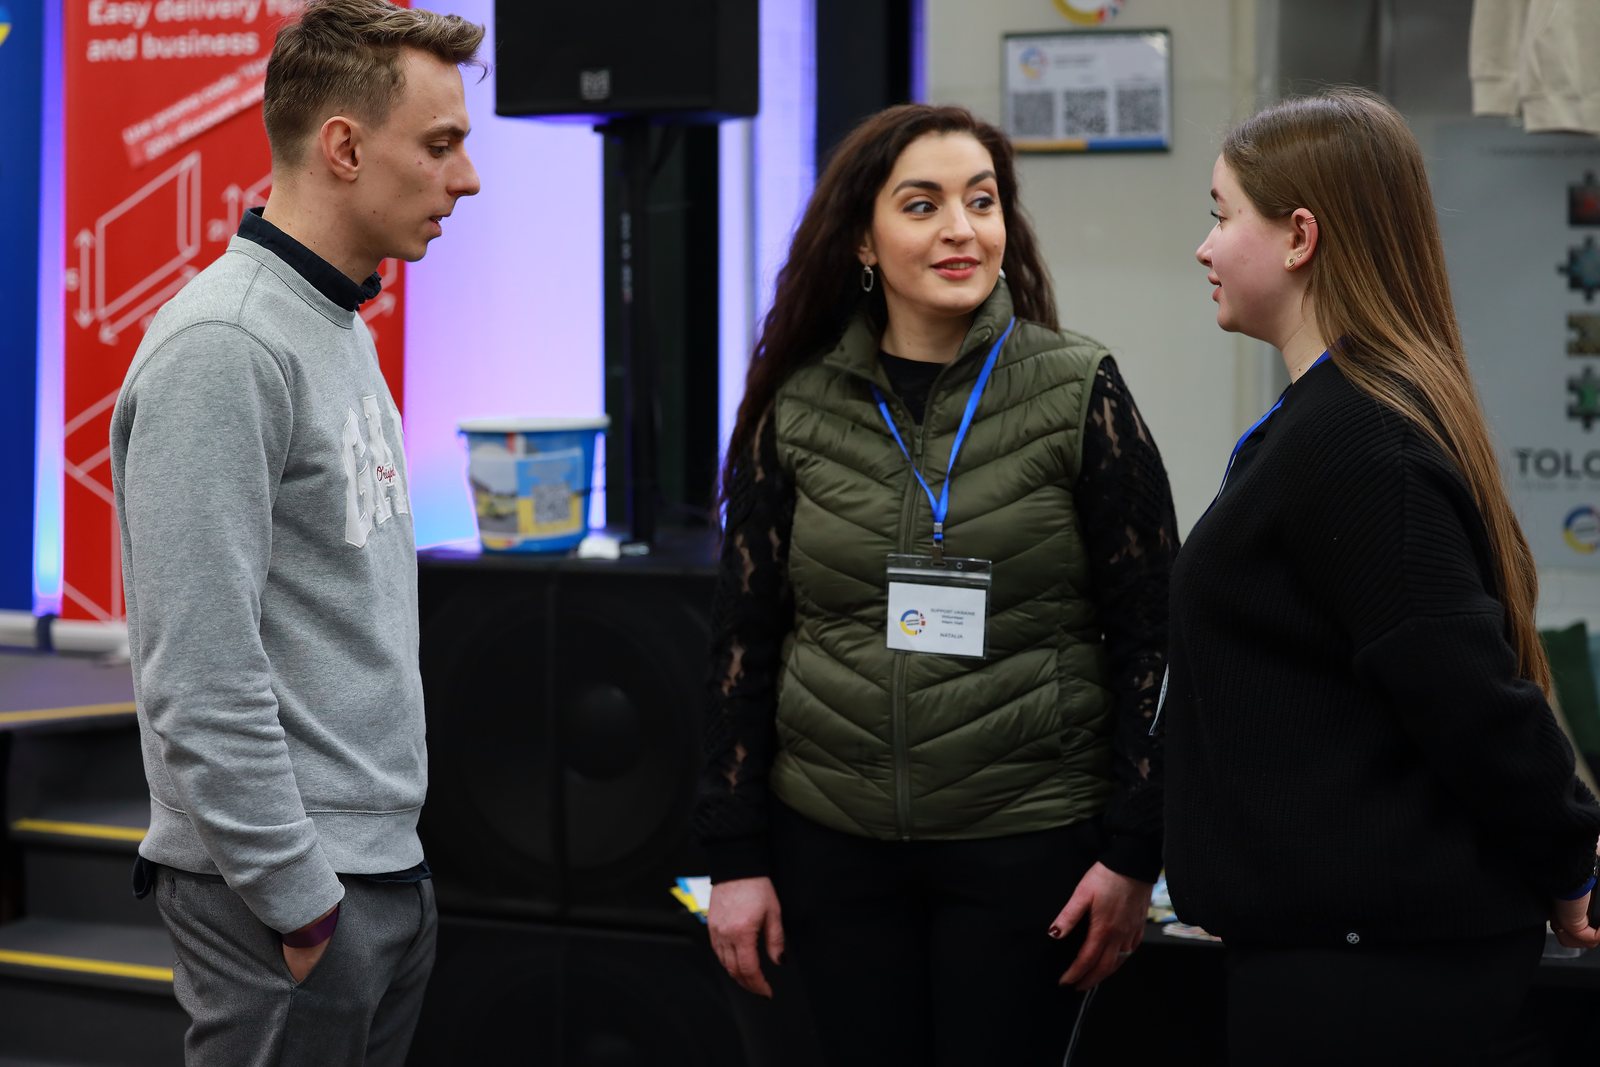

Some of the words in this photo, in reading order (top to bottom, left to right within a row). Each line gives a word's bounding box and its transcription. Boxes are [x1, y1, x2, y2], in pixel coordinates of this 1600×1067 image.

[88, 0, 150, 28] Easy
[155, 0, 259, 23] delivery
[87, 33, 138, 61] and
[142, 29, 260, 59] business
